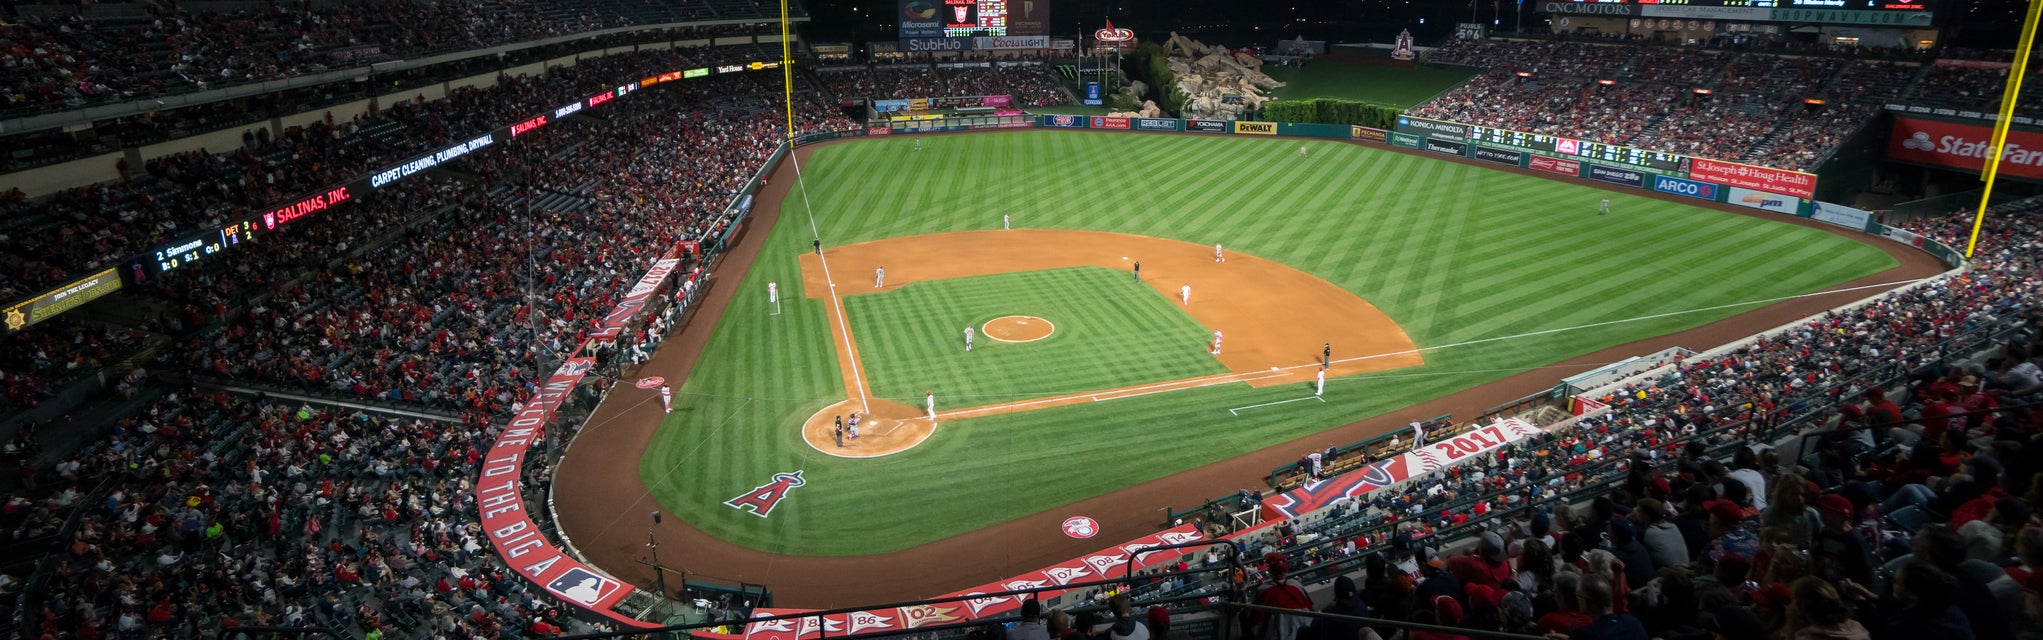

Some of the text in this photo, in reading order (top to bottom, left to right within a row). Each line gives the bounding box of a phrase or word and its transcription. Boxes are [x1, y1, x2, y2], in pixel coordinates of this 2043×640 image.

[1546, 3, 1630, 15] CNC MOTORS
[902, 21, 940, 29] Microsemi
[909, 39, 961, 51] StubHub
[992, 37, 1020, 48] Coors
[1020, 39, 1044, 47] LIGHT
[1410, 120, 1463, 134] KONICA MINOLTA
[1427, 143, 1458, 154] Thermador
[1936, 135, 1997, 160] State
[371, 133, 494, 188] CARPET CLEANING, PLUMBING, DRYWALL
[1606, 170, 1623, 178] DIEGO
[1747, 169, 1775, 183] Hoag
[1775, 173, 1808, 185] Health
[1658, 179, 1698, 195] ARCO
[276, 186, 351, 224] SALINAS, INC.
[225, 220, 258, 237] DET 3 6
[245, 231, 252, 240] 2
[156, 239, 203, 261] 2 Simmons
[54, 278, 99, 302] JOIN THE LEGACY
[1435, 426, 1507, 460] 2017
[480, 379, 574, 579] WELCOME TO THE BIG A
[1093, 556, 1113, 567] '08
[1054, 568, 1073, 579] '07
[907, 606, 937, 620] '02
[854, 616, 876, 626] '86
